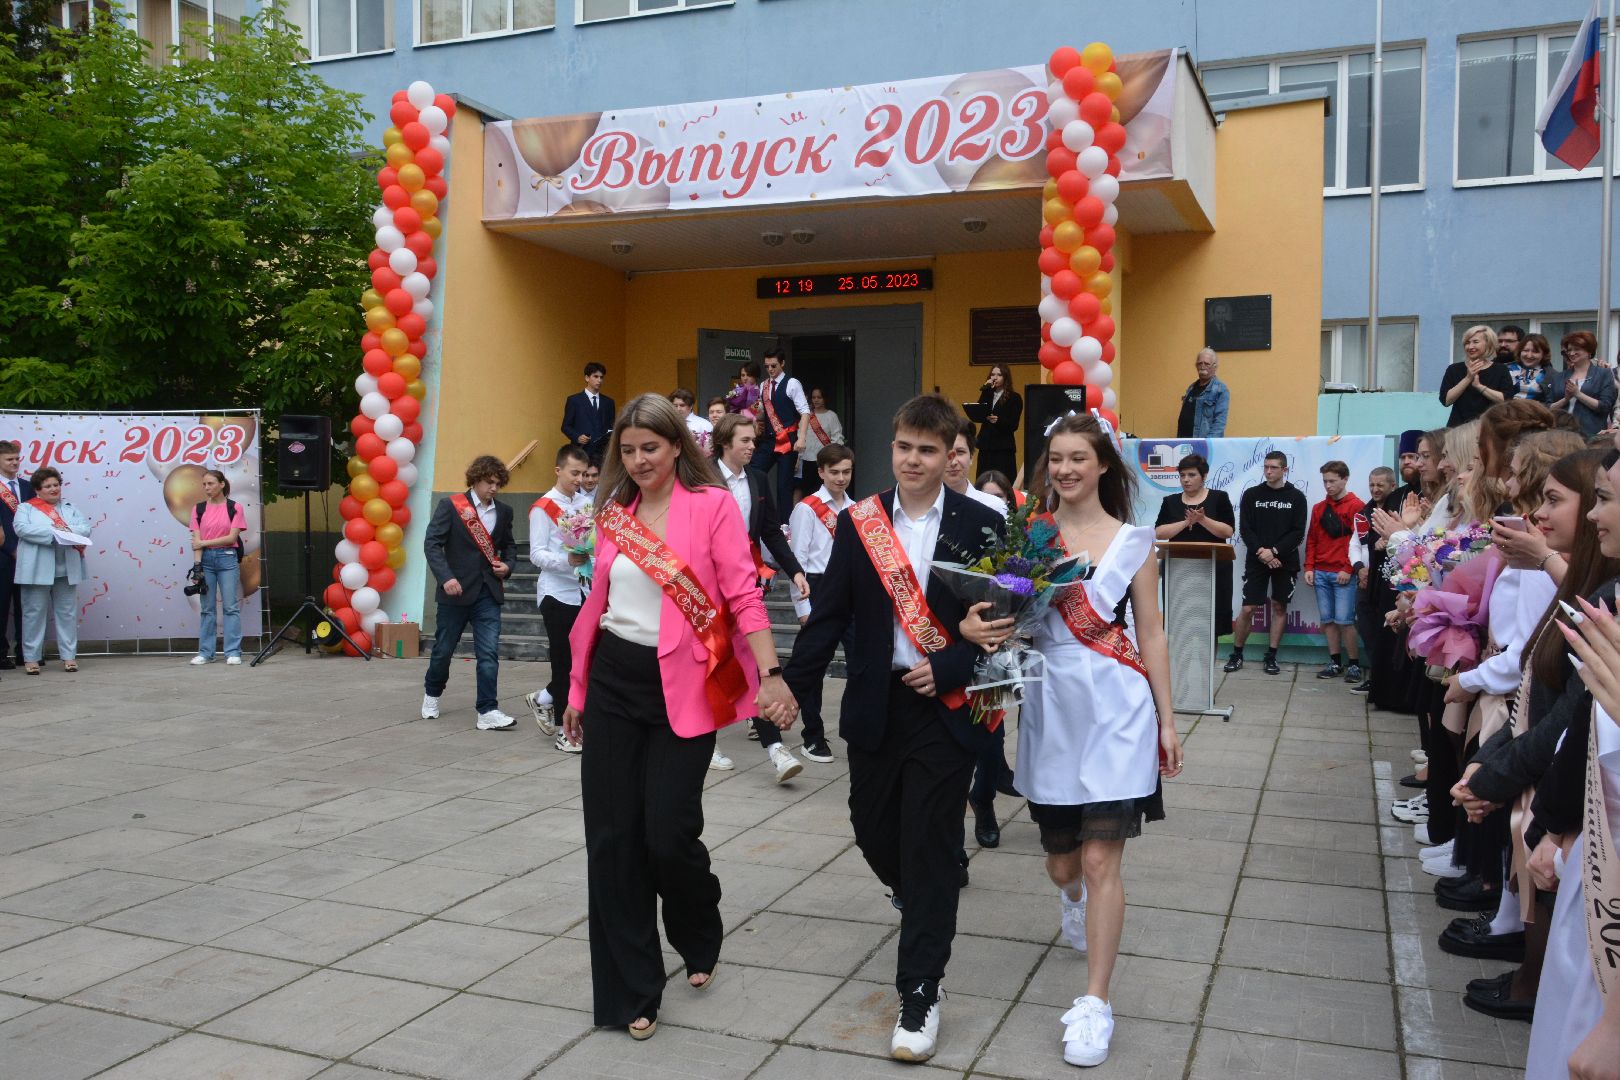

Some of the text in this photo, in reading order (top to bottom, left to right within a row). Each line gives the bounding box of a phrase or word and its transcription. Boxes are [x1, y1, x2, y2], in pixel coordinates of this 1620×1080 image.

[570, 90, 1050, 199] Выпуск 2023
[775, 280, 791, 293] 12
[798, 279, 813, 292] 19
[725, 348, 751, 358] ВЫХОД
[119, 425, 244, 464] 2023
[861, 517, 920, 622] Выпускник
